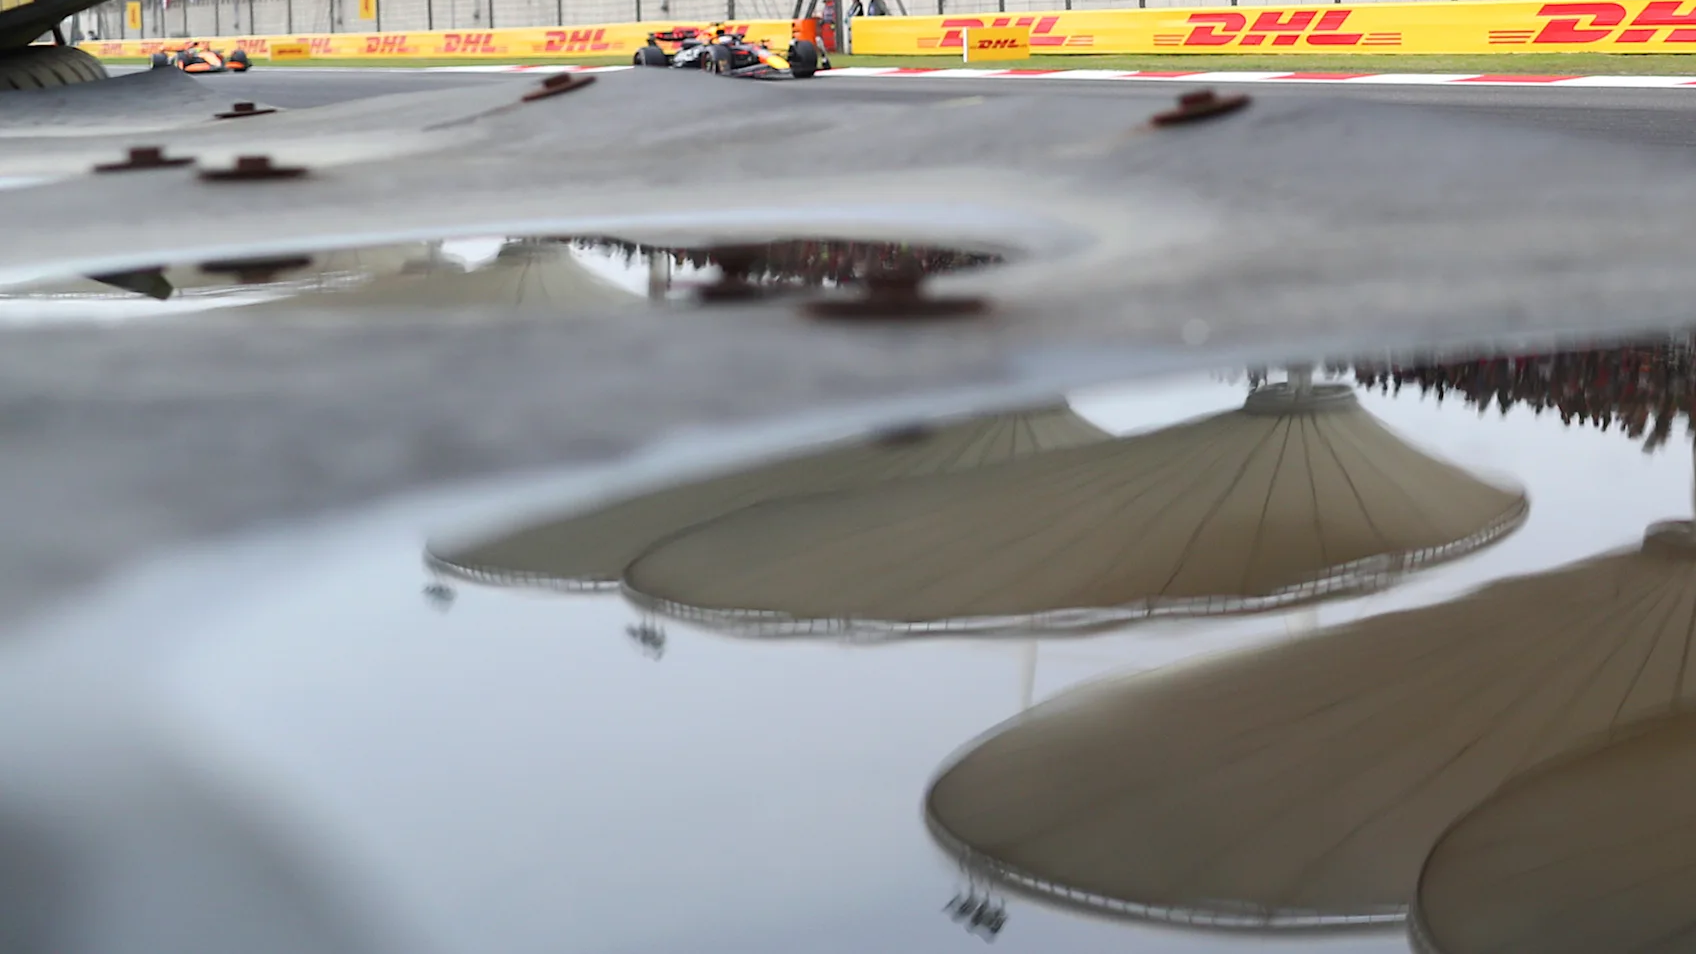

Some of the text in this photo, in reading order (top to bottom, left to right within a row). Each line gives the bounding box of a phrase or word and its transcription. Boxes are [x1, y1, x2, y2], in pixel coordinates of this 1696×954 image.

[1183, 9, 1364, 46] DHL
[366, 35, 408, 53] DHL
[443, 33, 495, 53] DHL
[545, 29, 609, 51] DHL
[977, 39, 1020, 49] DHL
